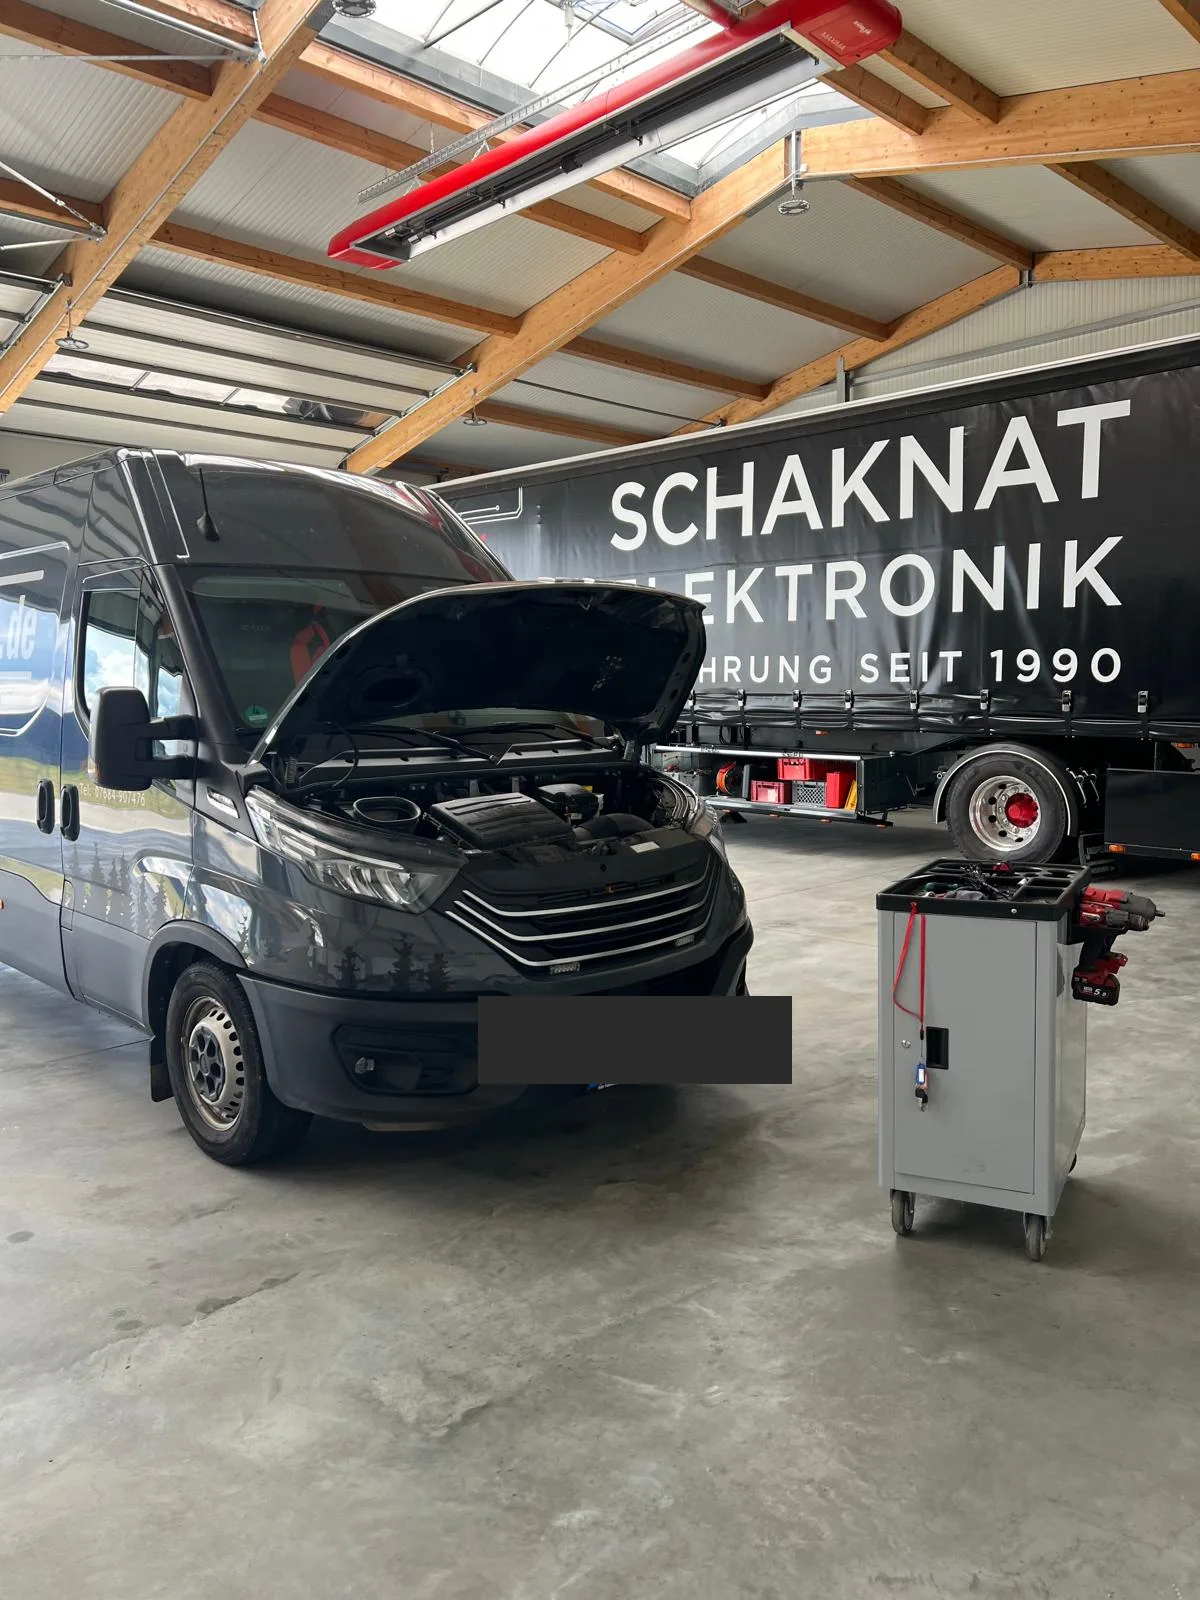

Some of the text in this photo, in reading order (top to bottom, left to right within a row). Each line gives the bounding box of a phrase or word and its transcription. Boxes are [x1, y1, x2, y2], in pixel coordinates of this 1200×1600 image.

[610, 399, 1131, 551] SCHAKNAT
[616, 535, 1123, 627] EKTRONIK
[699, 647, 1121, 685] HRUNG SEIT 1990
